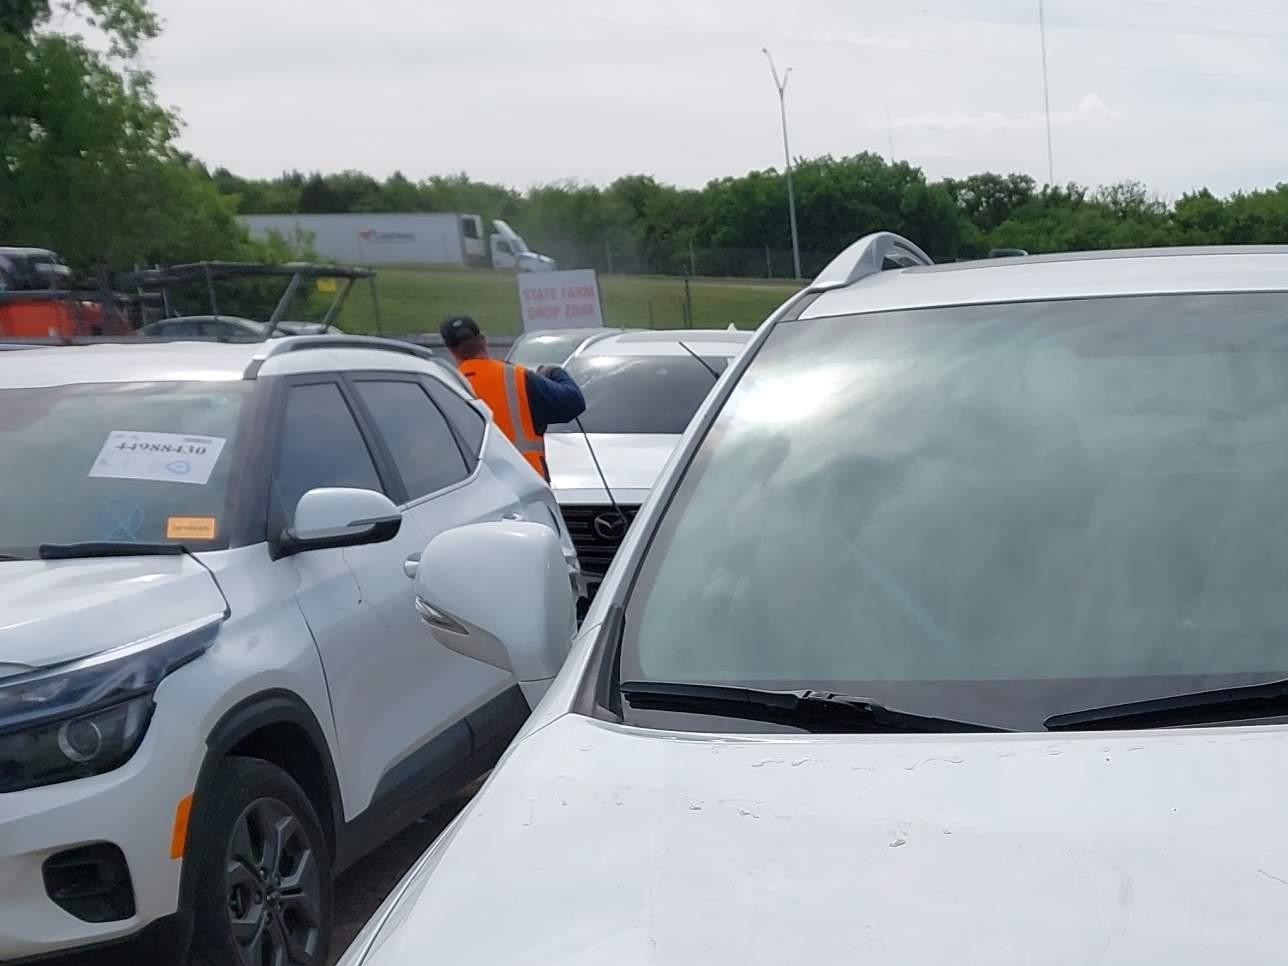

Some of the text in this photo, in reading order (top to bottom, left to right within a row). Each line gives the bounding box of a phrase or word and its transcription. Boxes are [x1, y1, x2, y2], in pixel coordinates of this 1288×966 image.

[523, 285, 595, 302] STATE FARM
[527, 303, 595, 320] DROP ZONE
[114, 441, 207, 456] 44988430
